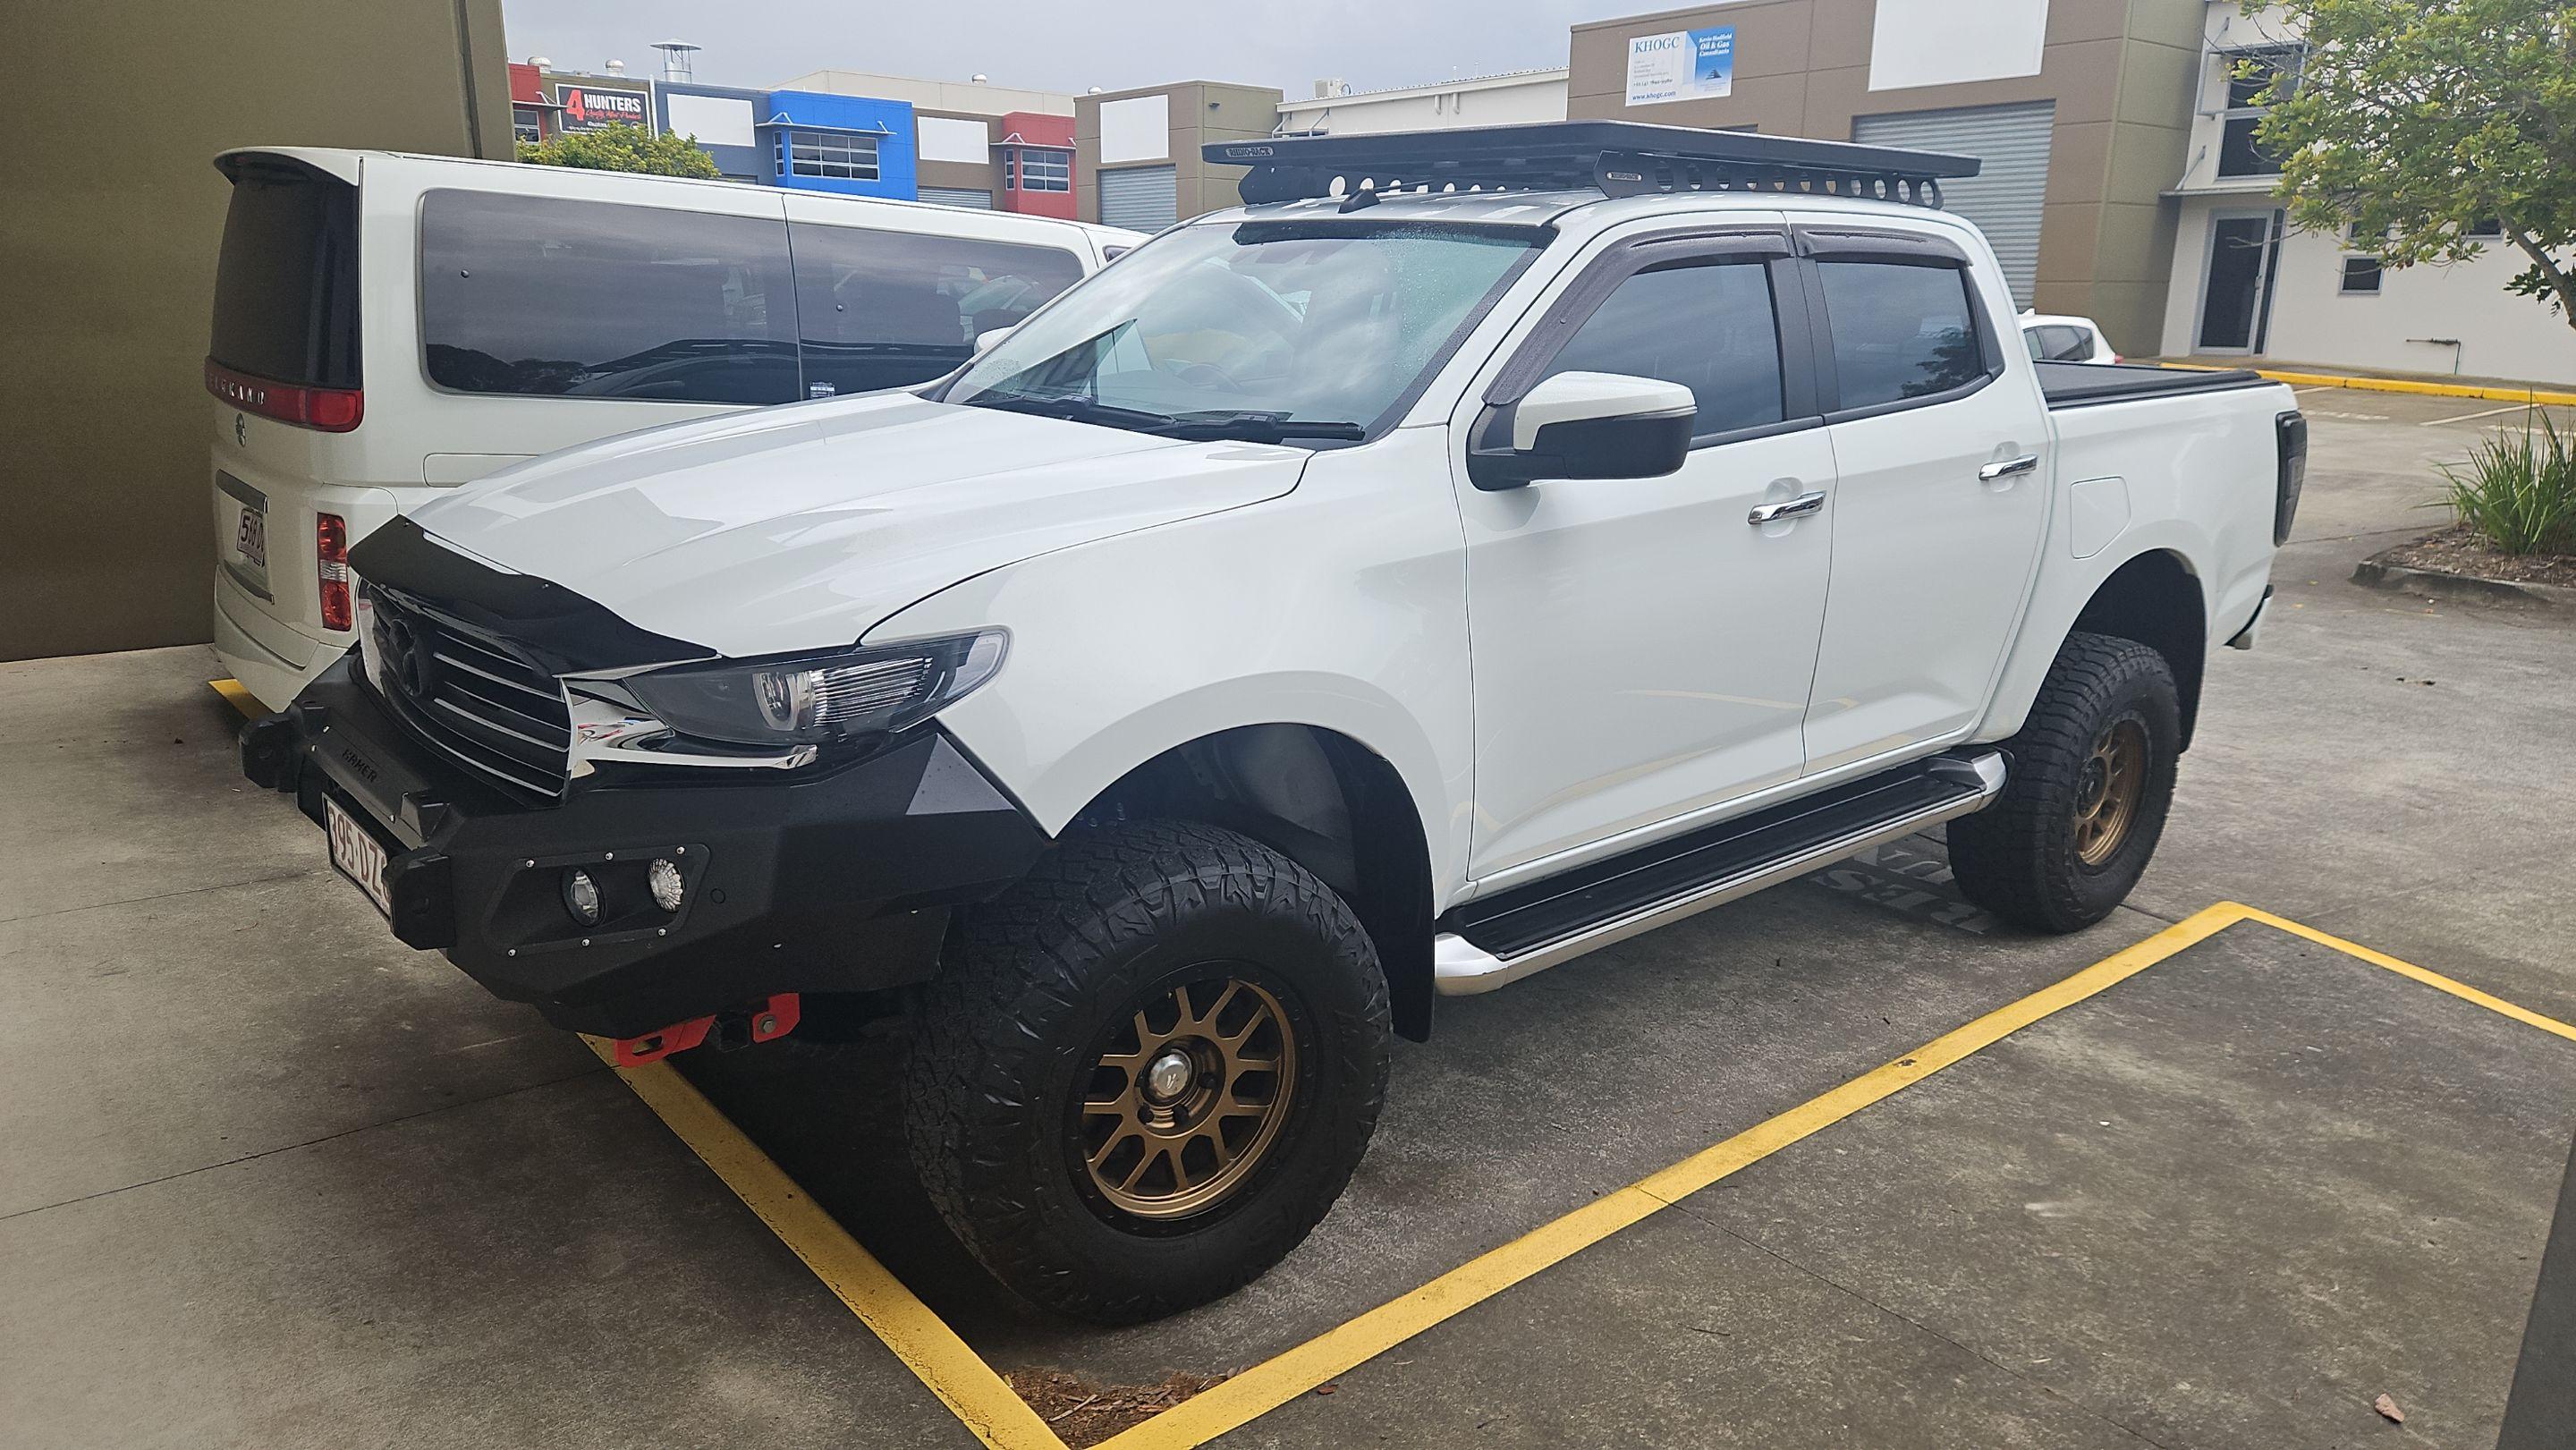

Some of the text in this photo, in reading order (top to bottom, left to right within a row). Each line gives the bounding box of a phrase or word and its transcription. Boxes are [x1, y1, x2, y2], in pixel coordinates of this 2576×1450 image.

[1634, 36, 1681, 54] KHOGC
[1699, 41, 1710, 50] Oil
[1716, 40, 1730, 49] Gas
[1632, 90, 1676, 101] www.khogc.com
[566, 89, 641, 121] 4 HUNTERS
[1229, 147, 1271, 157] RHINO-RACK
